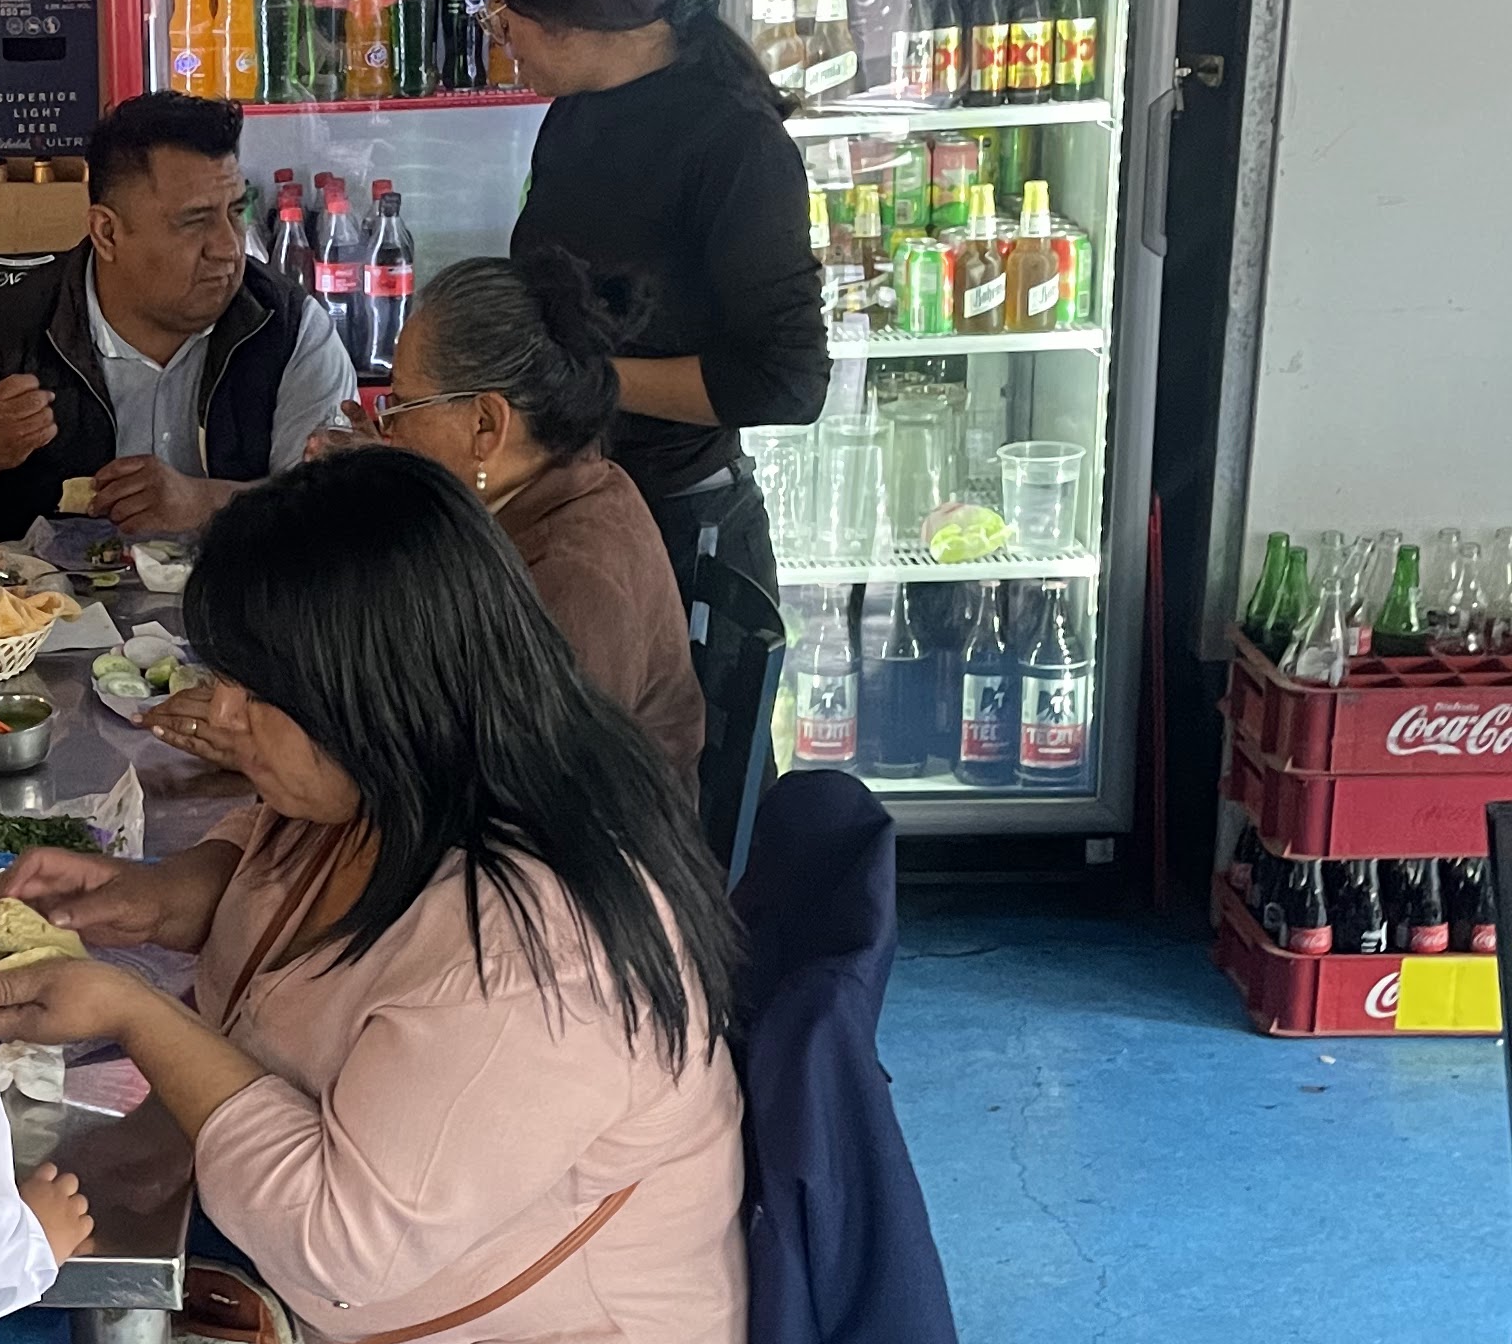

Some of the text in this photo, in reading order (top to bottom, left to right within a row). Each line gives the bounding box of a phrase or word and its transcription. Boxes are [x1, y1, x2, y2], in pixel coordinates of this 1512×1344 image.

[13, 107, 61, 119] LIGHT
[17, 123, 57, 134] BEER
[45, 137, 83, 147] ULTR
[1386, 703, 1512, 756] Coca-Co
